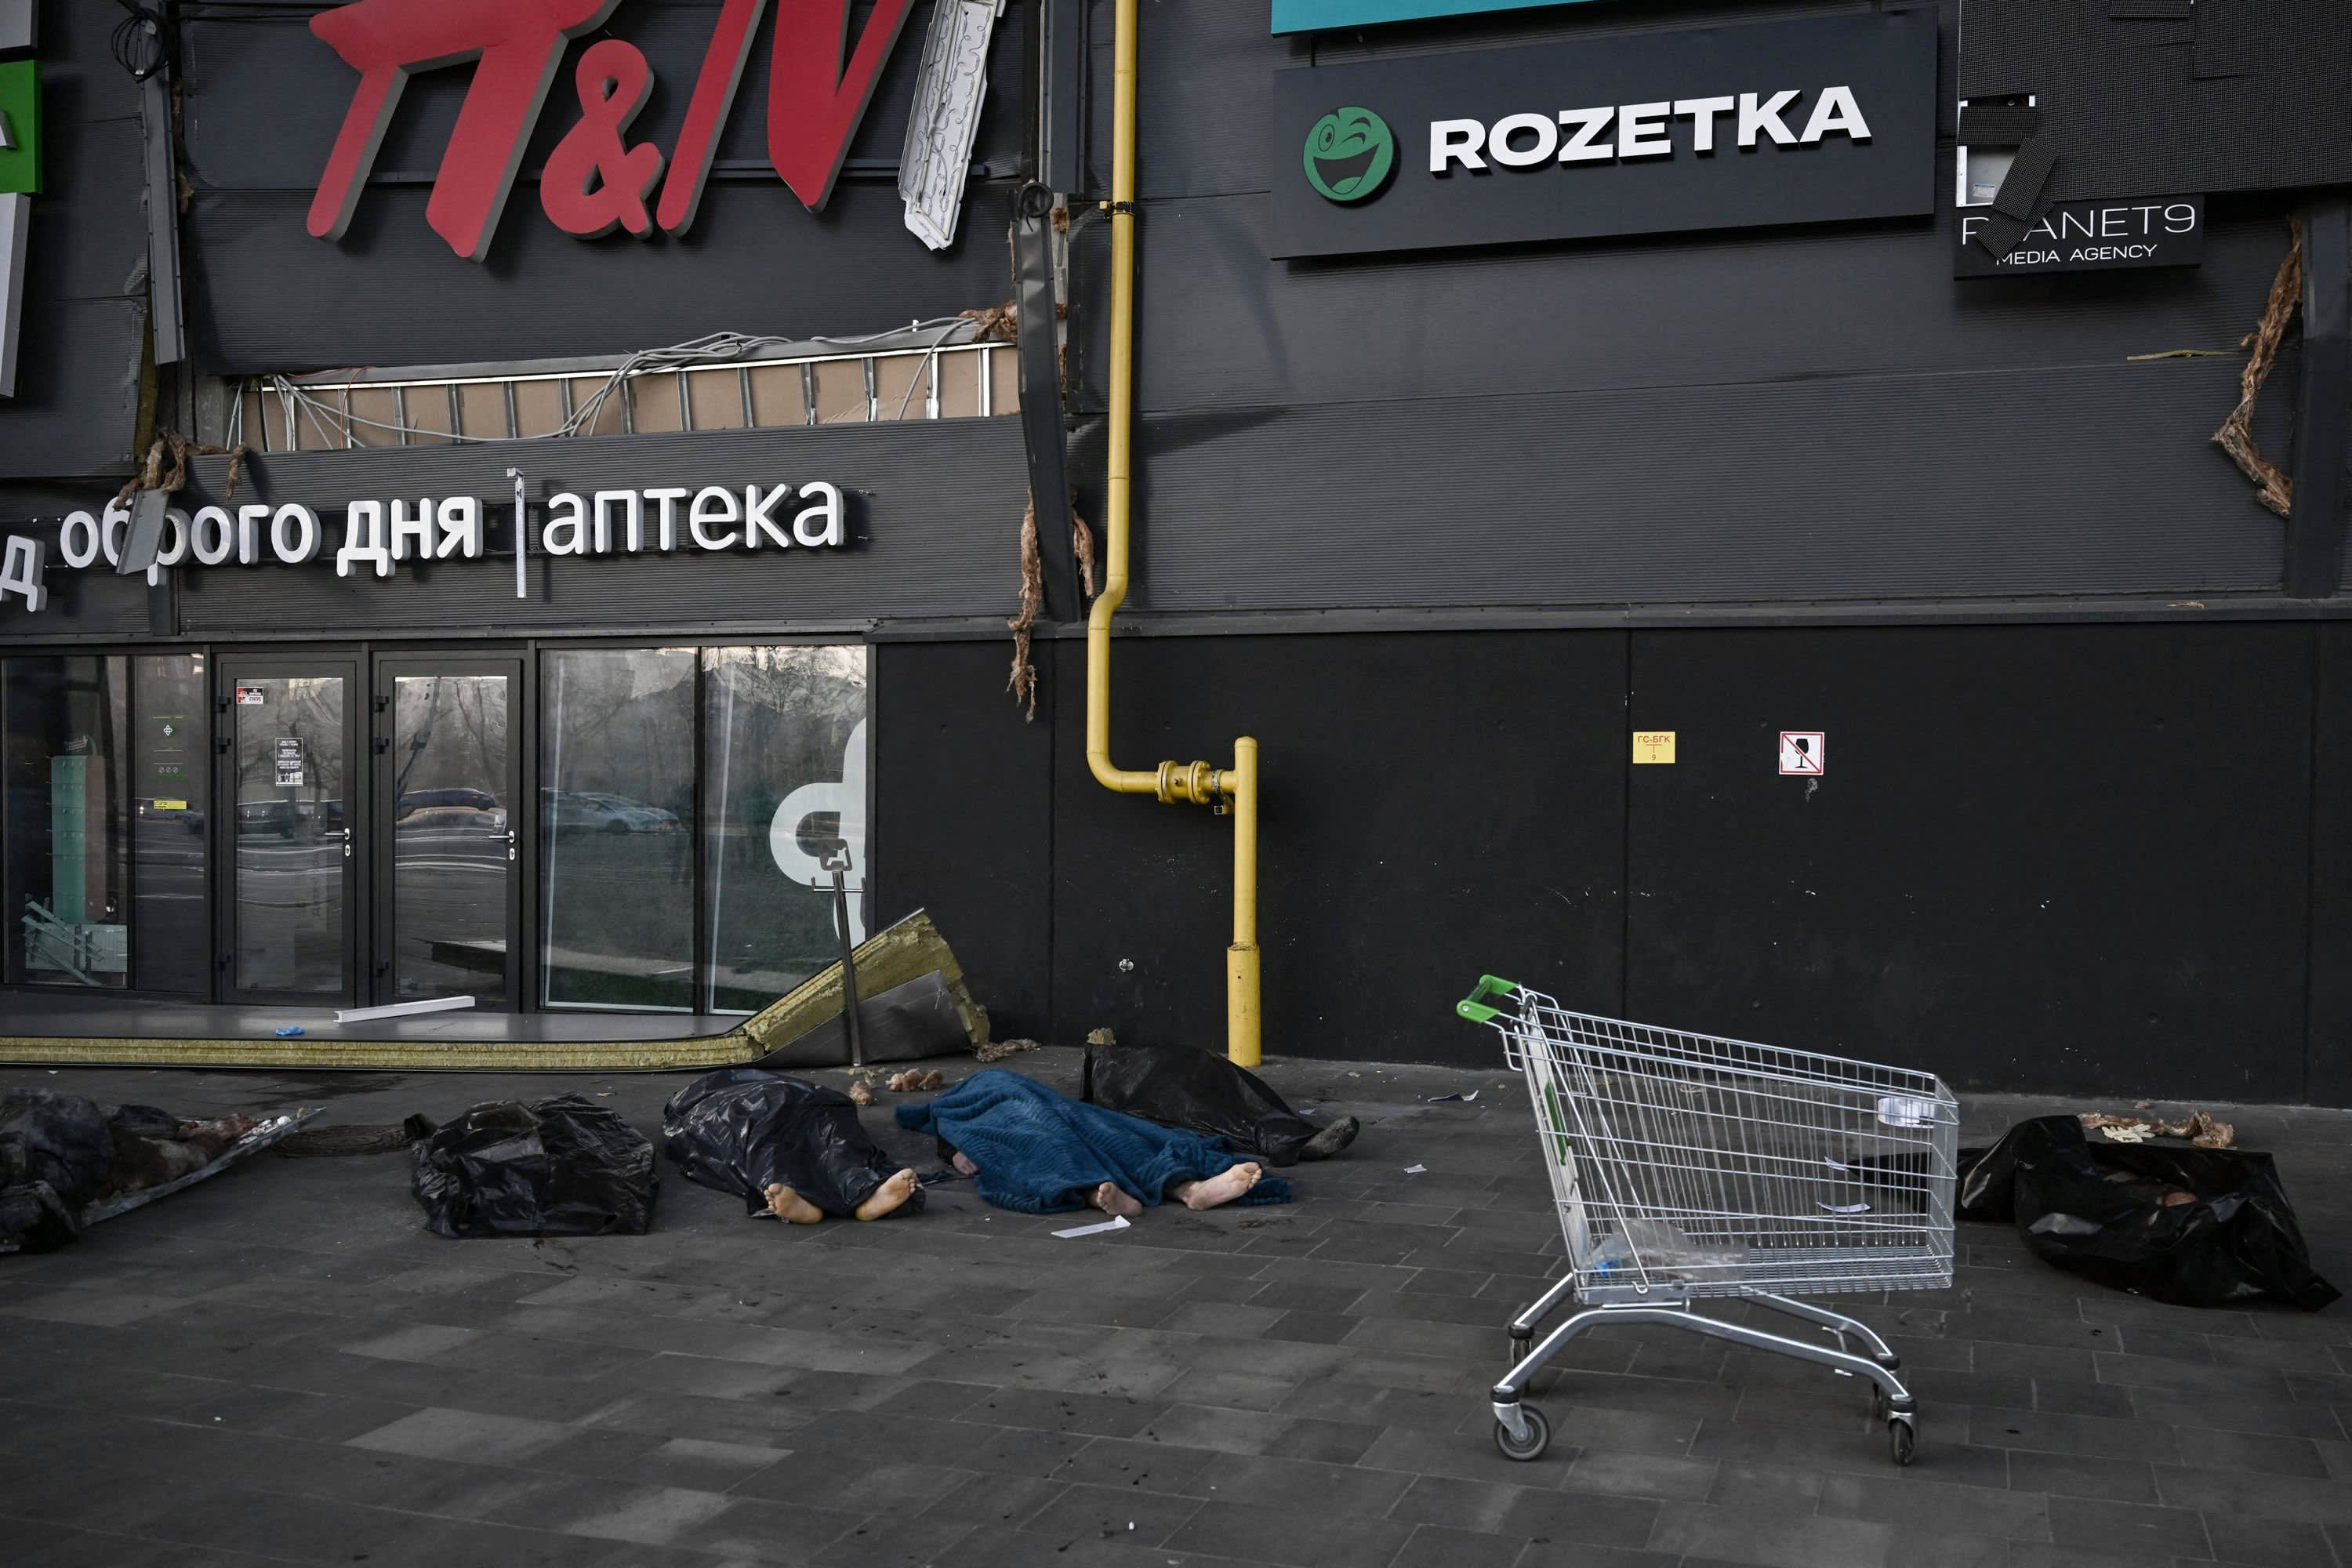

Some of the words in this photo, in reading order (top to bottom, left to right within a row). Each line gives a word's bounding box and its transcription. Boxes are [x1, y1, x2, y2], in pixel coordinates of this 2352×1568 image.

[1430, 85, 1873, 172] ROZETKA
[1962, 203, 2196, 245] PANET9
[1996, 250, 2060, 266] MEDIA
[2070, 244, 2158, 262] AGENCY
[336, 496, 481, 577] дня
[543, 481, 847, 556] аптека
[1637, 735, 1671, 744] ГС-БГК
